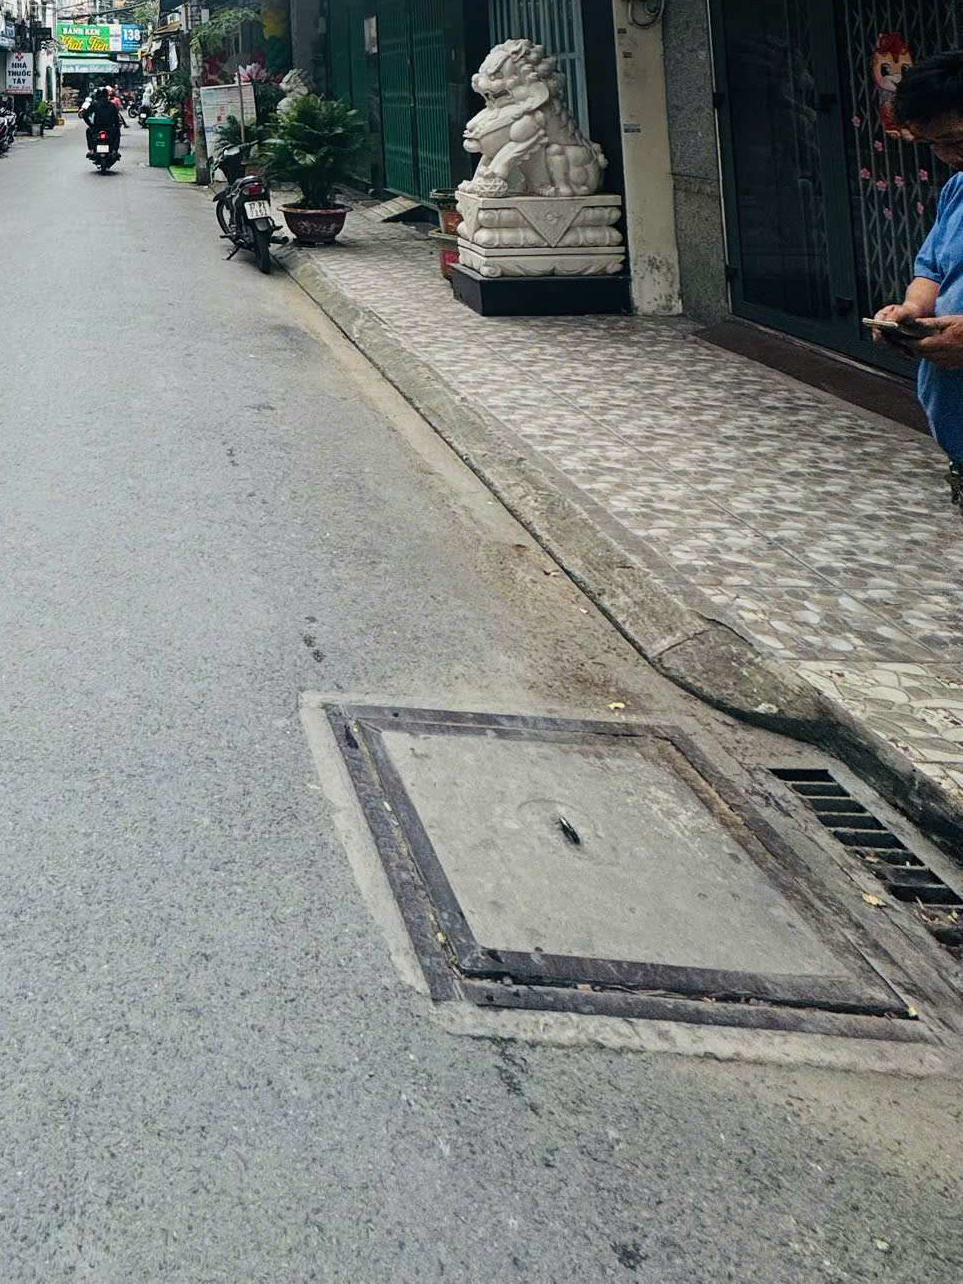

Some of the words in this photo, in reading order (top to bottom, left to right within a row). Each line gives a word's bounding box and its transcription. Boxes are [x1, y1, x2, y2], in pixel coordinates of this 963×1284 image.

[123, 28, 141, 41] 138
[11, 61, 27, 69] NHÀ
[13, 77, 26, 85] TÂY
